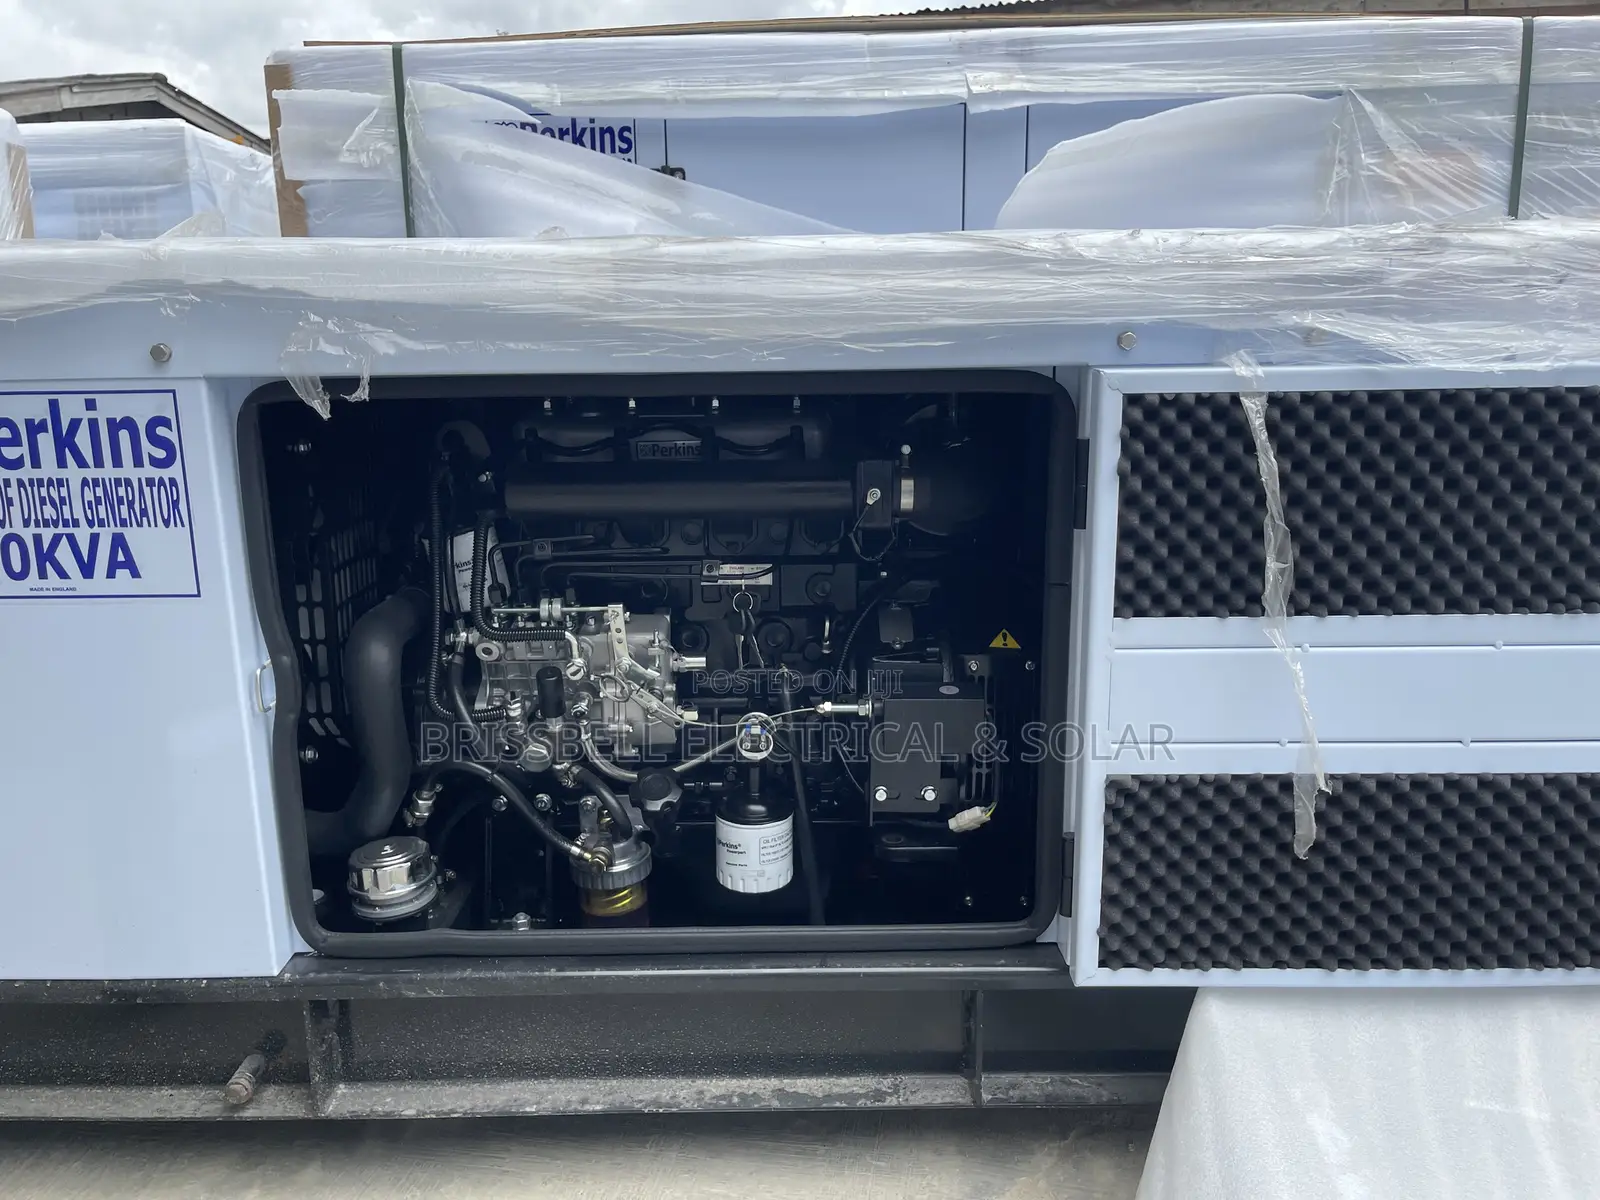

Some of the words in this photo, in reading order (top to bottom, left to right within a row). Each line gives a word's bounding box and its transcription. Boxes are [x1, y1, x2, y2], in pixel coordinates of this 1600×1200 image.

[0, 398, 177, 471] erkins
[652, 442, 701, 457] Perkins
[16, 476, 80, 529] DIESEL
[80, 475, 186, 530] GENERATOR
